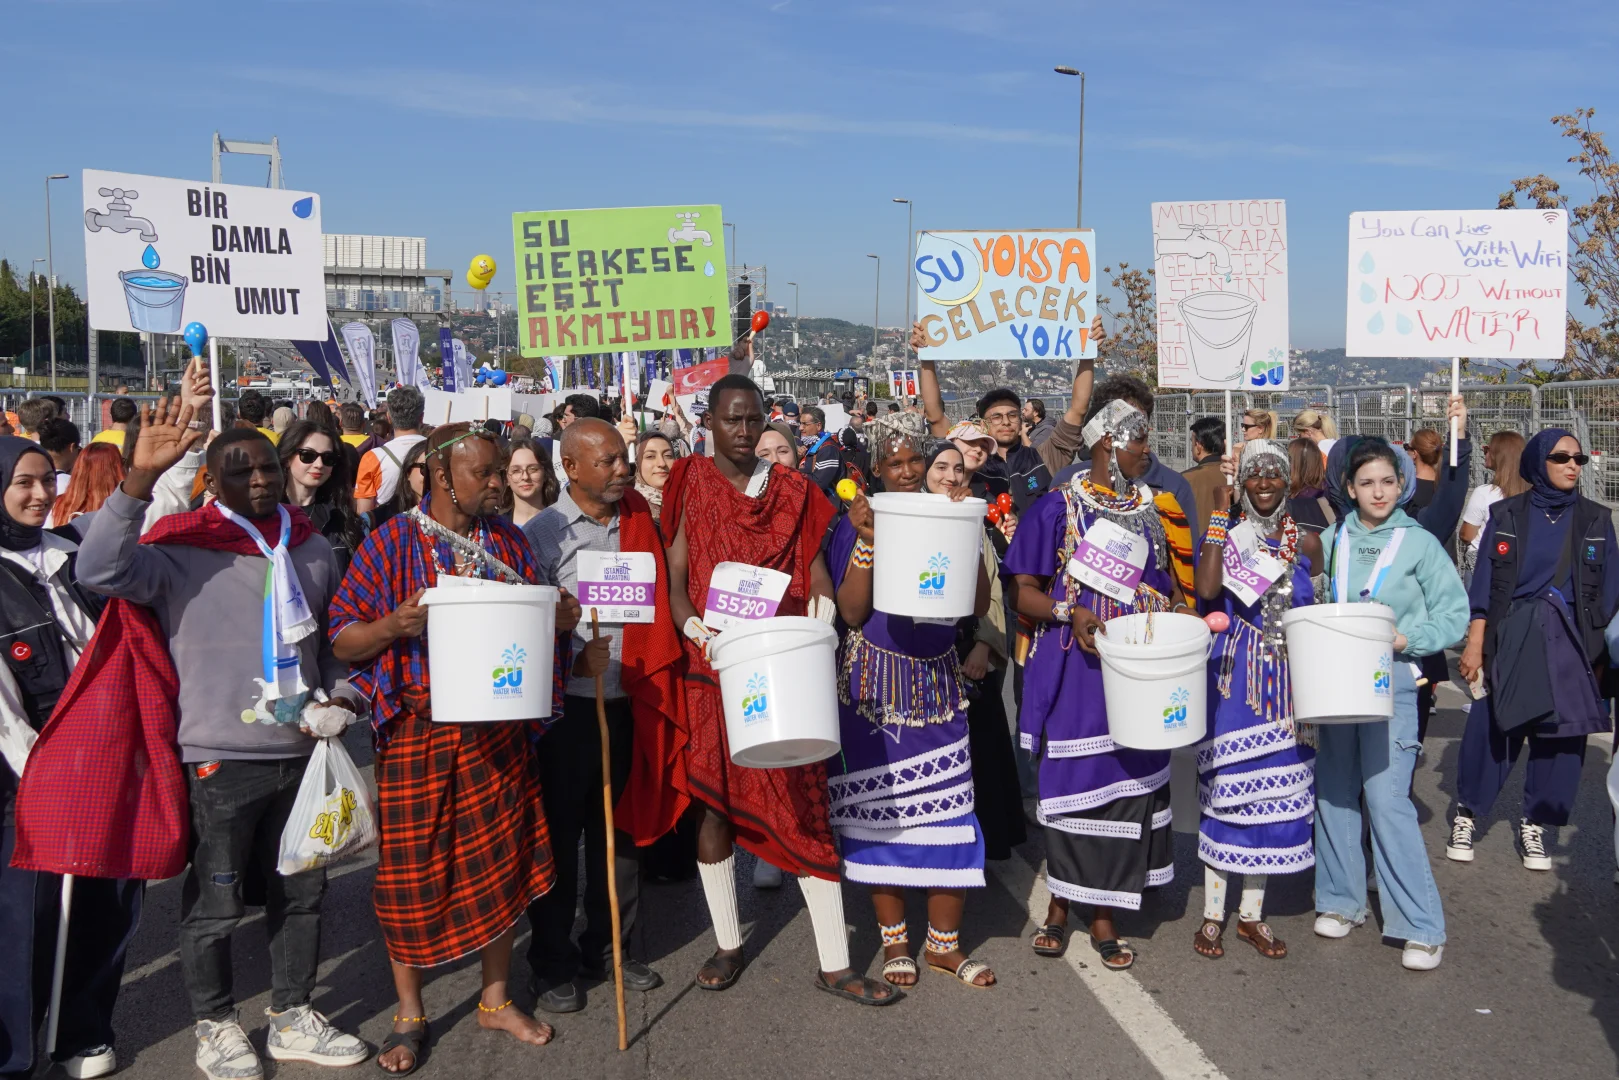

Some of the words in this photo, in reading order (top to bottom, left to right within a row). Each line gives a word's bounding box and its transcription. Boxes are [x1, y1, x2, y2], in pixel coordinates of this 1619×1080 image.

[187, 186, 228, 219] BİR
[212, 224, 292, 255] DAMLA
[523, 219, 570, 248] SU
[1216, 228, 1286, 251] KAPA
[1357, 217, 1405, 239] You
[1410, 216, 1450, 239] Can
[1455, 216, 1492, 236] Live
[190, 253, 231, 285] BİN
[525, 245, 695, 280] HERKESE
[915, 250, 964, 293] SU
[972, 234, 1091, 284] YOKSA
[234, 286, 300, 315] UMUT
[526, 277, 624, 313] EŞİT
[1385, 272, 1472, 304] NOT
[528, 307, 716, 348] AKMIYOR!
[919, 285, 1088, 347] GELECEK
[1417, 306, 1540, 352] WATER
[1009, 323, 1090, 358] YOK!
[1251, 360, 1284, 387] SU
[1083, 547, 1135, 582] 55287
[1223, 544, 1260, 586] 55286
[1359, 547, 1380, 555] NASA
[588, 585, 646, 602] 55288
[919, 572, 945, 589] SU
[492, 667, 523, 688] SU
[742, 693, 768, 716] SU
[1163, 704, 1187, 723] SU
